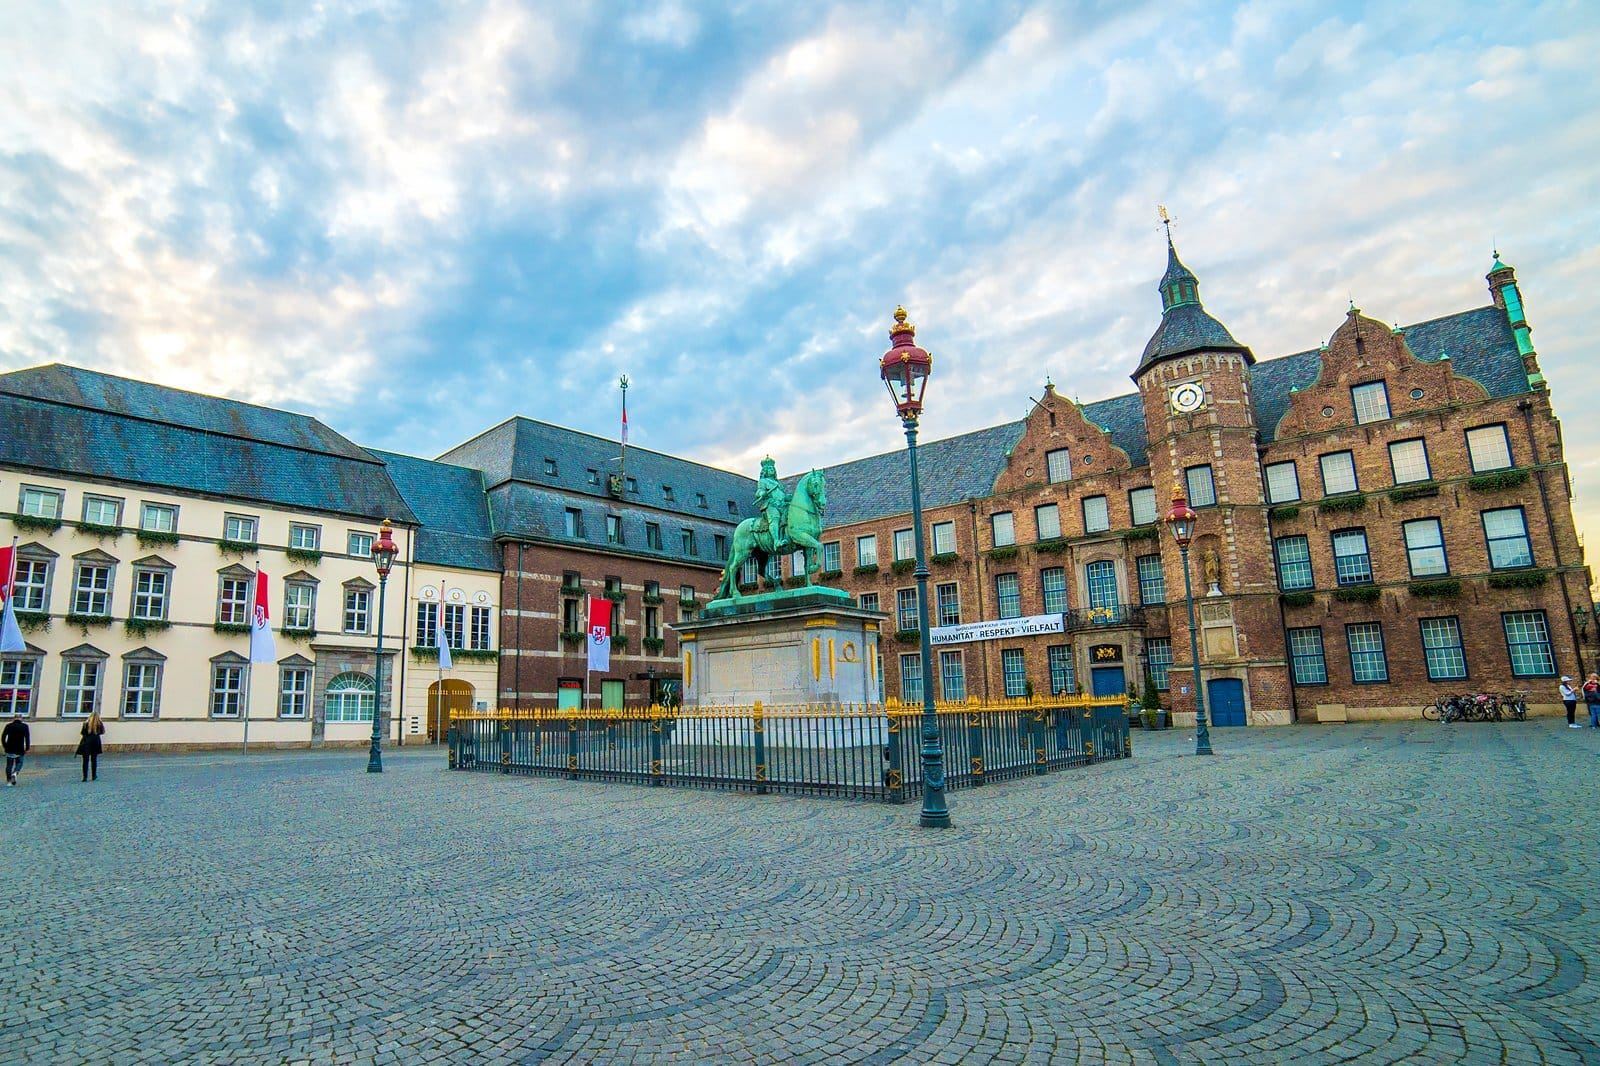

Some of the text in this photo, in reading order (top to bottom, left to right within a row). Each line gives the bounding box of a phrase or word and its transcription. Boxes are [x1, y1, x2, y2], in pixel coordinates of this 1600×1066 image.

[932, 631, 974, 643] HUMANITÄT
[980, 627, 1015, 638] RESPEKT
[1022, 622, 1060, 633] VIELFALT
